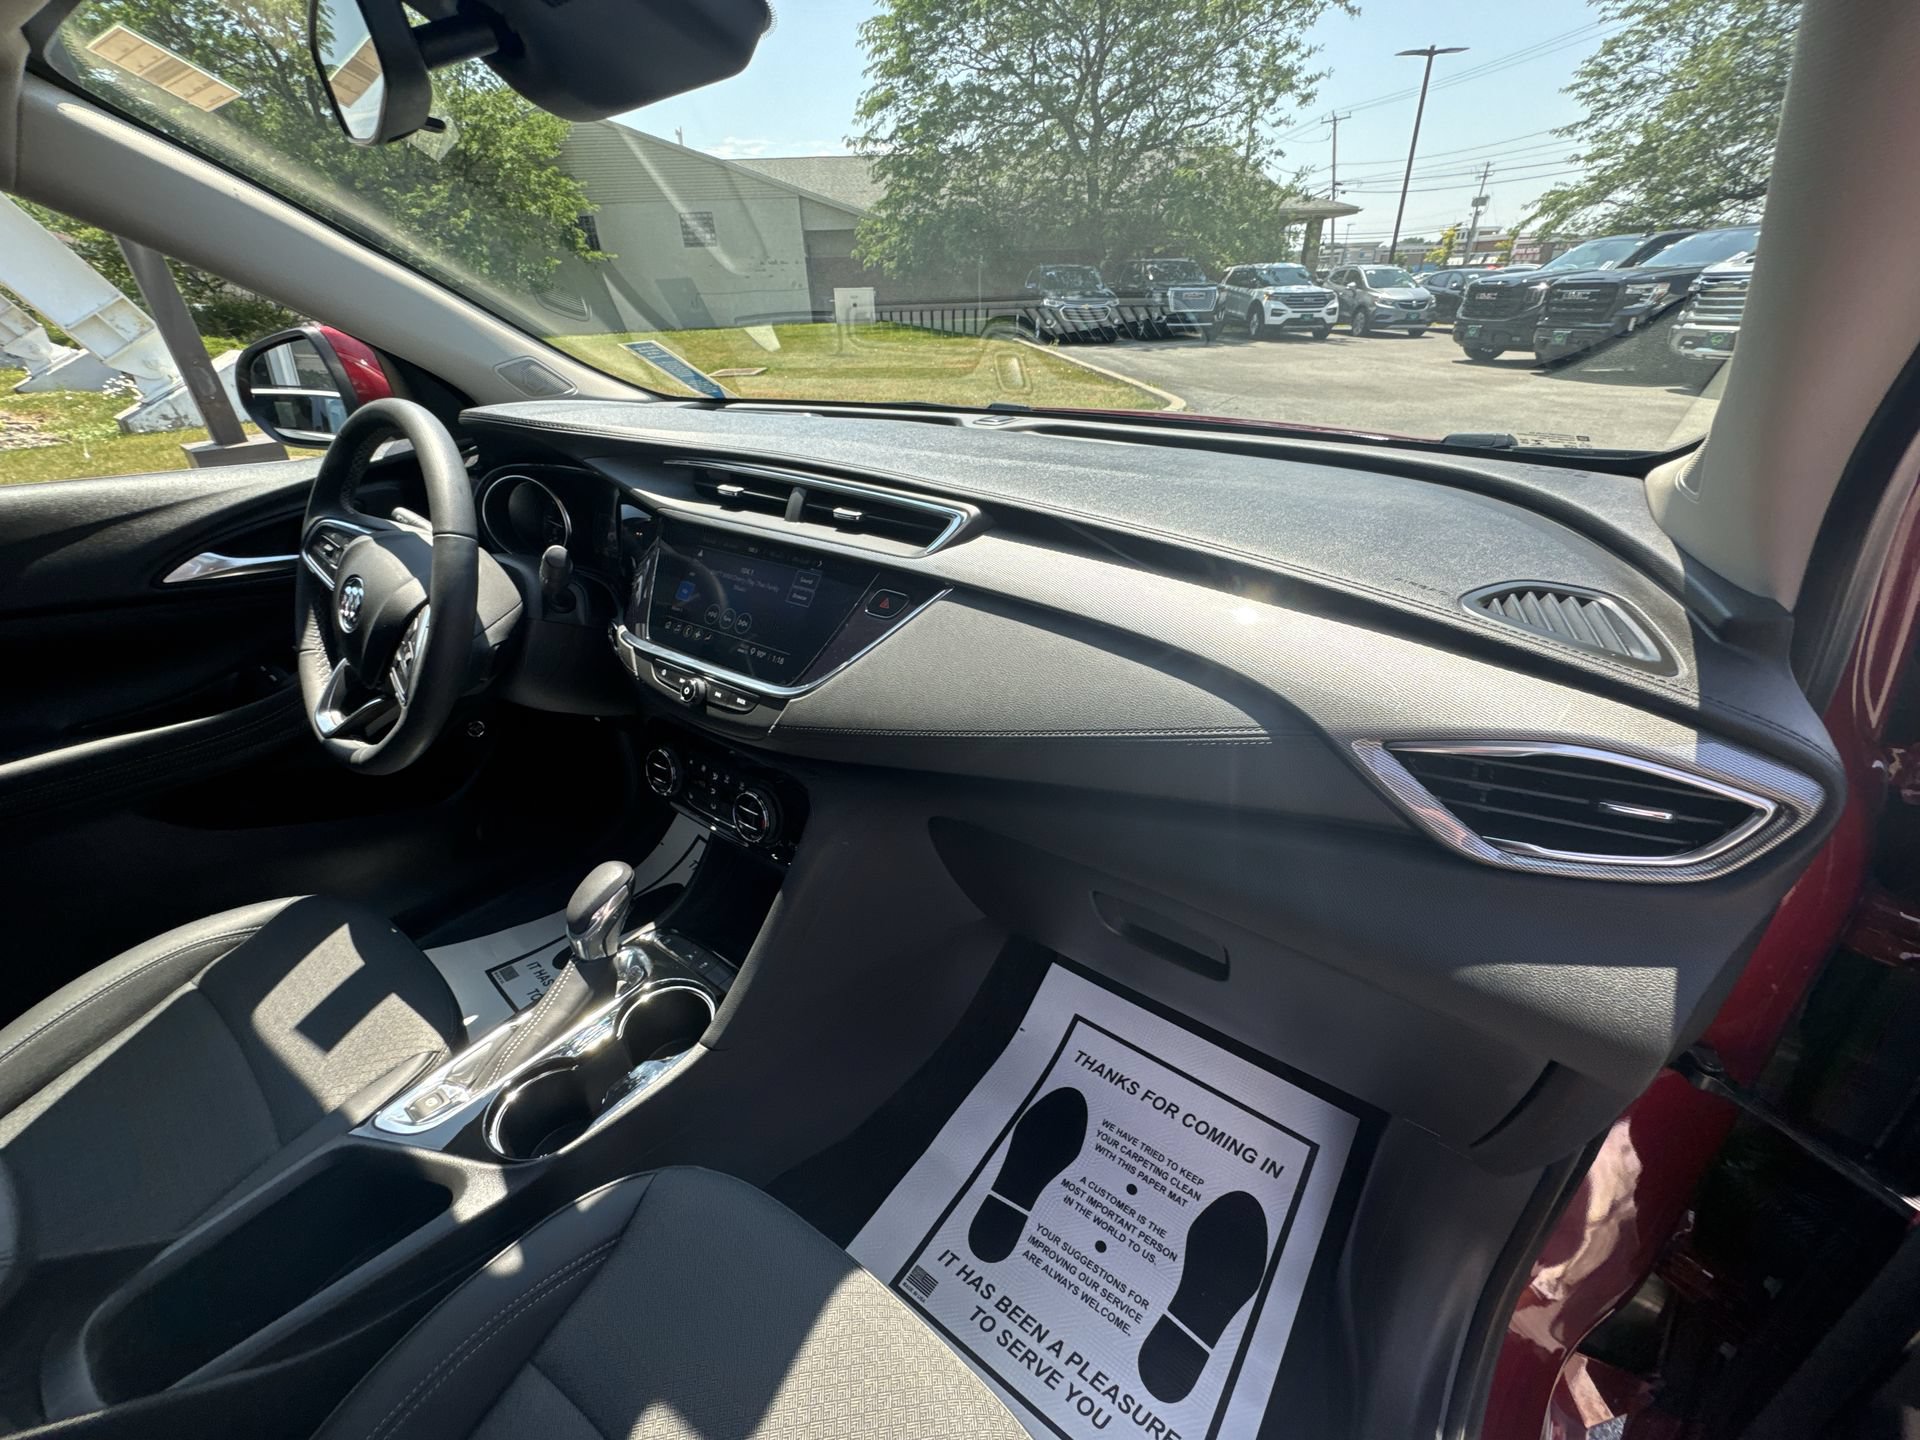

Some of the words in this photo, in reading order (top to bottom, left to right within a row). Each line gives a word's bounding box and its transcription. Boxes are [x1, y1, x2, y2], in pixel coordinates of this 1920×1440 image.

[1074, 1050, 1140, 1096] THANKS
[1140, 1089, 1180, 1119] FOR
[1181, 1113, 1259, 1164] COMING
[1259, 1156, 1285, 1180] IN
[1101, 1118, 1117, 1132] WE
[1115, 1126, 1140, 1146] HAVE
[1140, 1142, 1165, 1163] TRIED
[1166, 1158, 1179, 1171] TO
[1179, 1167, 1205, 1186] KEEP
[1080, 1176, 1087, 1185] A
[1088, 1181, 1136, 1218] CUSTOMER
[1136, 1214, 1147, 1225] IS
[1148, 1220, 1168, 1239] THE
[1094, 1142, 1117, 1162] WITH
[1117, 1156, 1137, 1175] THIS
[1136, 1171, 1167, 1194] PAPER
[1167, 1190, 1189, 1208] MAT
[1096, 1129, 1120, 1149] YOUR
[1120, 1145, 1169, 1180] CARPETING
[1170, 1176, 1202, 1202] CLEAN
[1060, 1178, 1087, 1199] MOST
[1086, 1195, 1138, 1234] IMPORTANT
[1138, 1230, 1178, 1262] PERSON
[1063, 1194, 1075, 1207] IN
[1075, 1202, 1093, 1220] THE
[1092, 1215, 1127, 1243] WORLD
[1127, 1238, 1141, 1253] TO
[1141, 1249, 1157, 1266] US.
[937, 1249, 961, 1270] IT
[955, 1263, 997, 1300] HAS
[995, 1294, 1051, 1344] BEEN
[1046, 1339, 1065, 1359] A
[1022, 1250, 1044, 1268] ARE
[1041, 1264, 1080, 1296] ALWAYS
[1080, 1290, 1132, 1337] WELCOME.
[1027, 1234, 1078, 1276] IMPROVING
[1078, 1271, 1101, 1292] OUR
[1100, 1287, 1144, 1325] SERVICE
[1035, 1222, 1062, 1246] YOUR
[1061, 1241, 1128, 1294] SUGGESTIONS
[1127, 1289, 1150, 1311] FOR
[969, 1305, 997, 1333] TO
[996, 1329, 1065, 1391] SERVE
[1064, 1382, 1112, 1430] YOU
